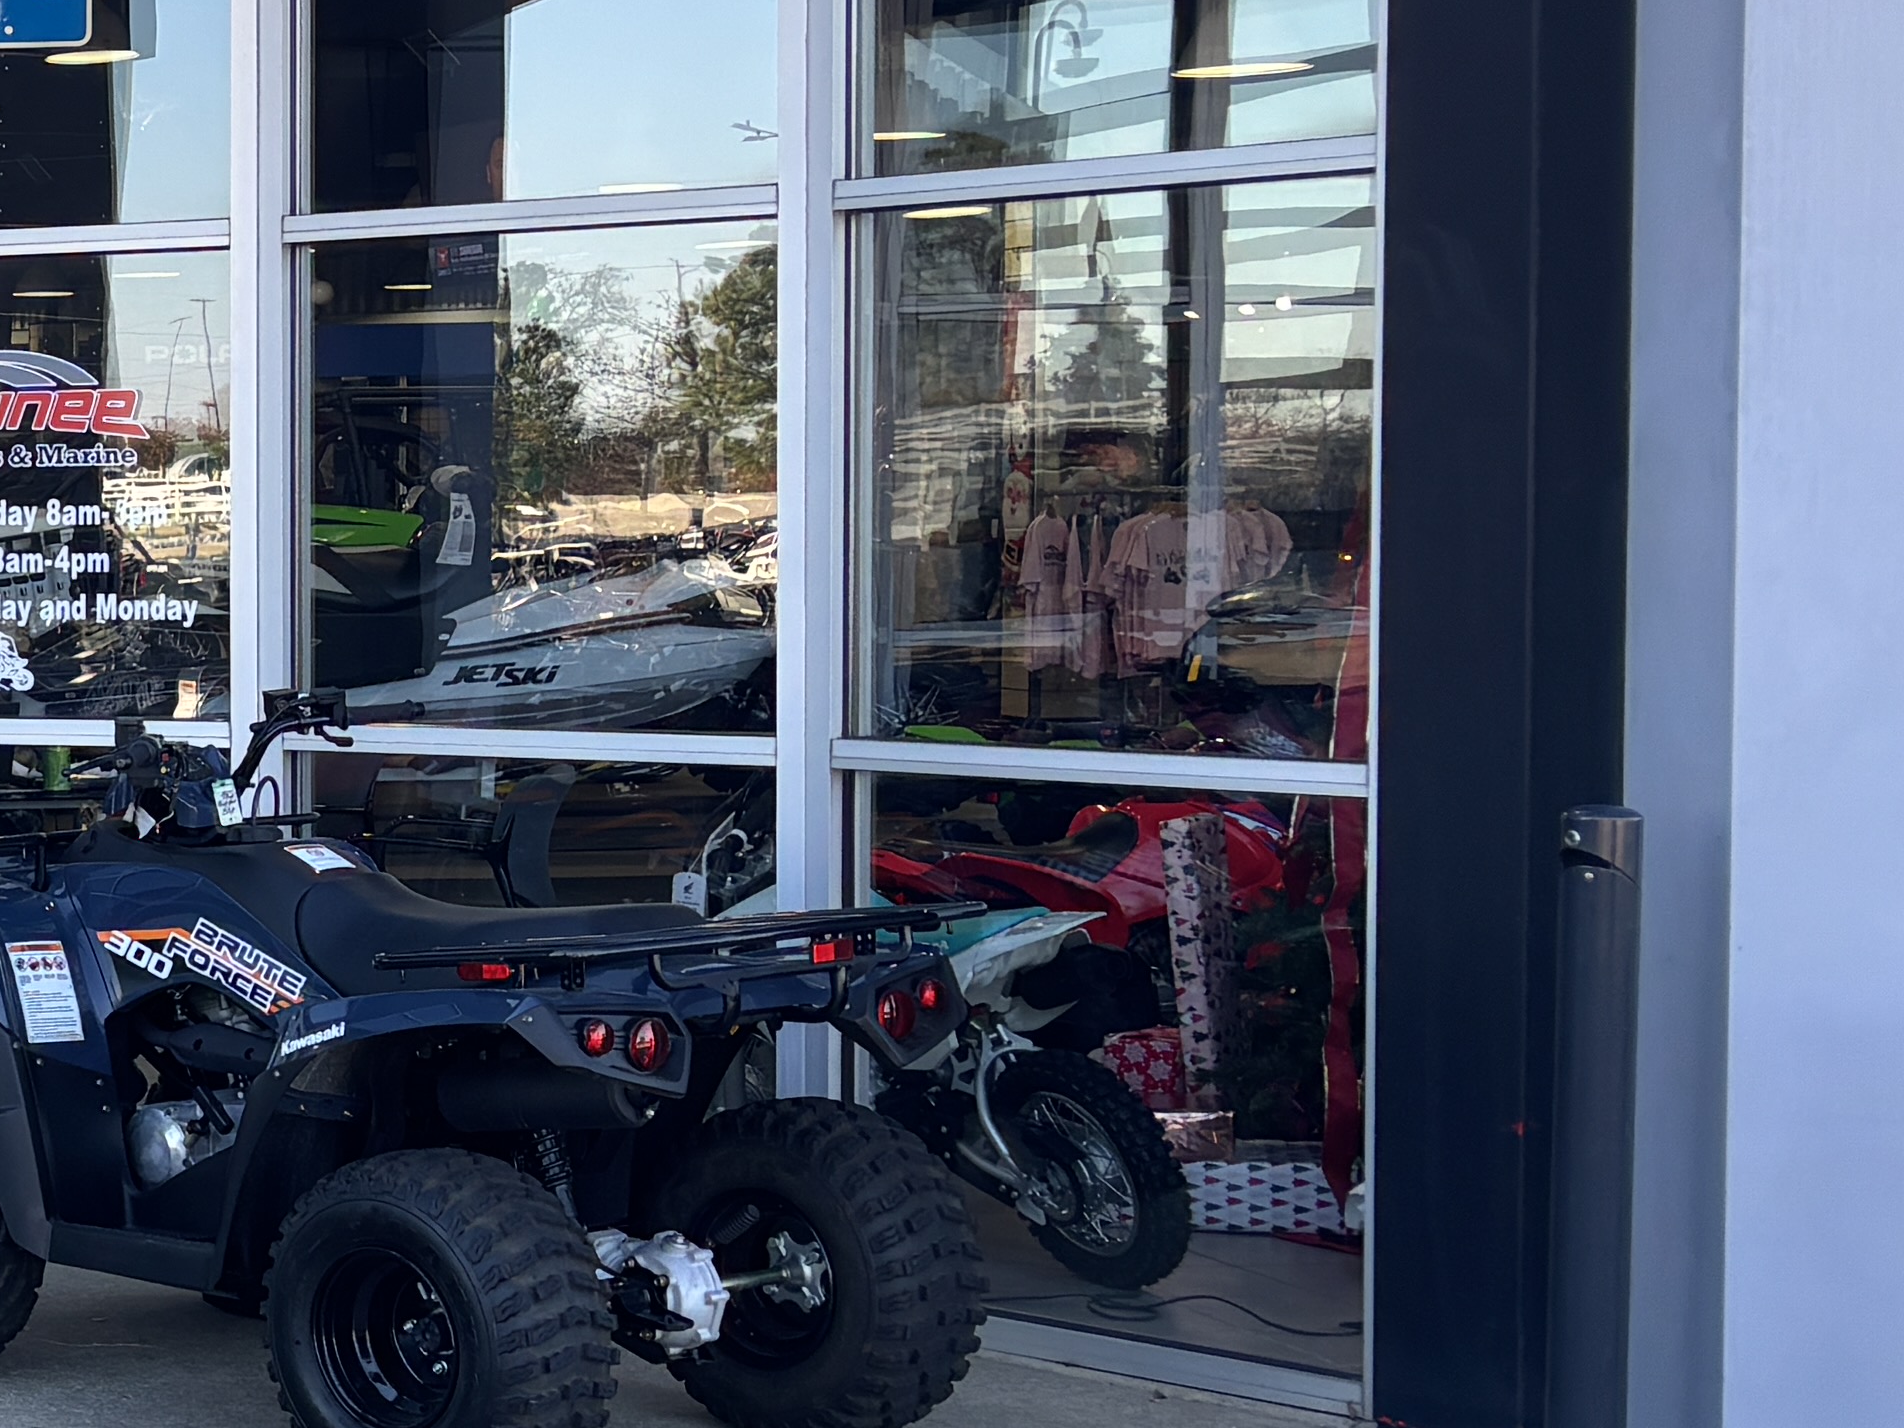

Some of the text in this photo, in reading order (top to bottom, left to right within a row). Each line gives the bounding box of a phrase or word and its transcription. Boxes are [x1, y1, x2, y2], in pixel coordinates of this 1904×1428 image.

[10, 445, 32, 468] &
[36, 443, 138, 469] Marine
[40, 593, 87, 622] and
[95, 593, 199, 628] Monday
[103, 928, 174, 981] 300
[162, 931, 276, 1013] FORCE
[189, 916, 307, 1001] BRUTE
[279, 1020, 347, 1058] Kawasaki
